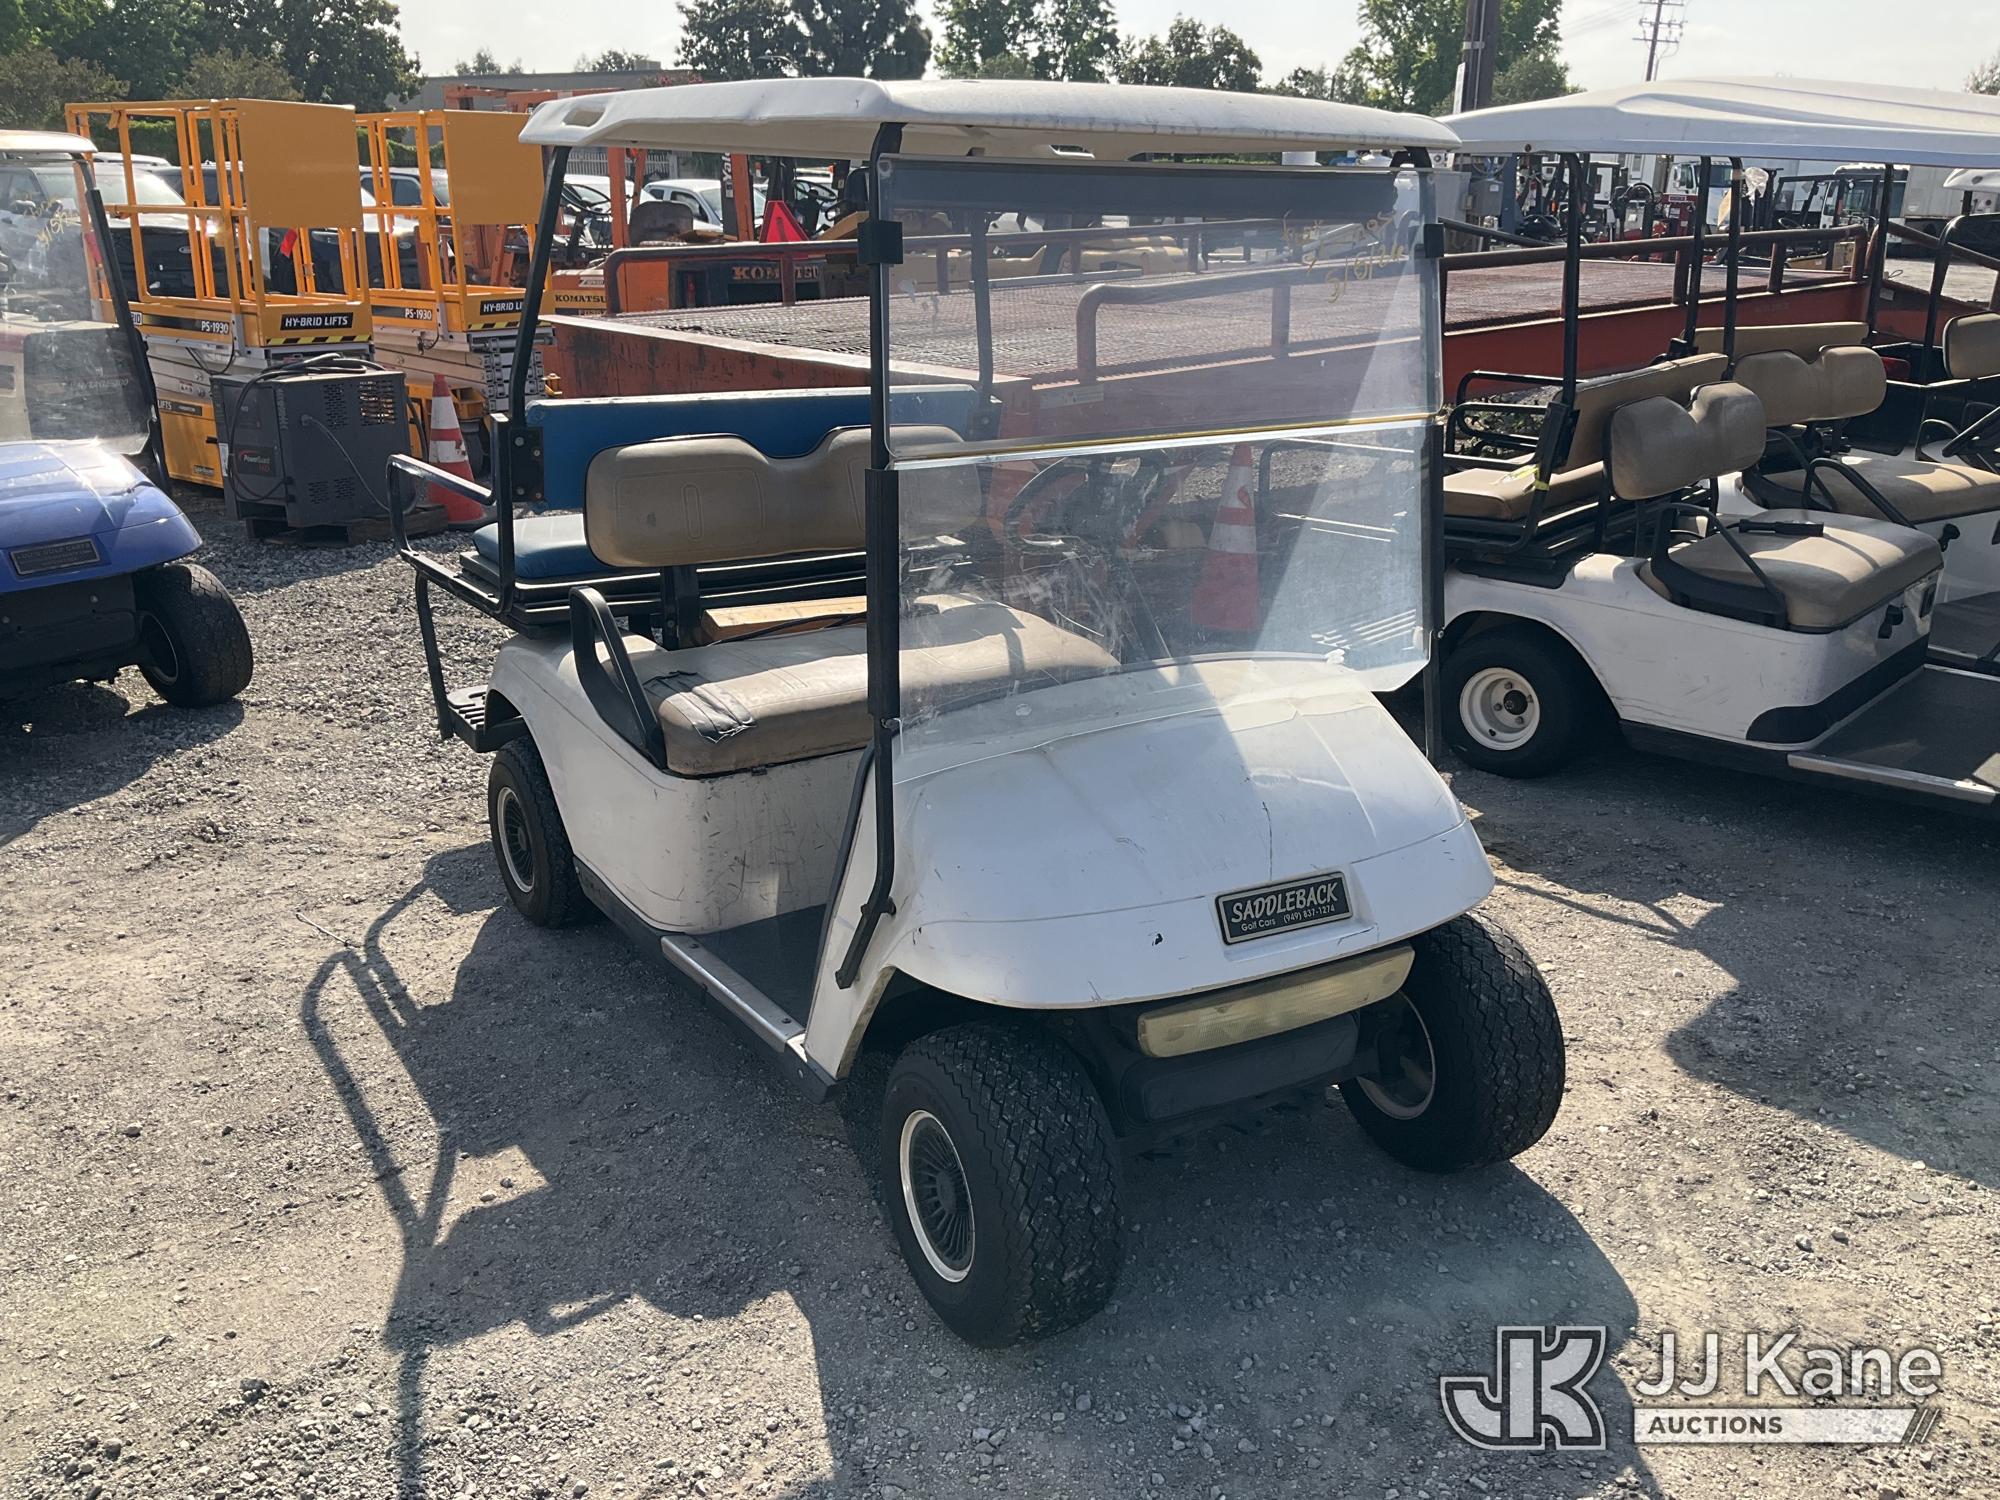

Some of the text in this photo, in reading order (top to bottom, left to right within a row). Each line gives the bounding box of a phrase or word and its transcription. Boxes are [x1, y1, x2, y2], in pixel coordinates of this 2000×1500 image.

[732, 265, 819, 280] KOMTSU
[483, 302, 513, 312] HY-BRID
[404, 308, 432, 320] PS-1930
[201, 321, 229, 334] PS-1930
[285, 316, 348, 327] HY-BRID LIFTS
[1231, 882, 1338, 923] SADDLEBACK
[1241, 921, 1257, 931] Golf
[1283, 911, 1302, 924] (949)
